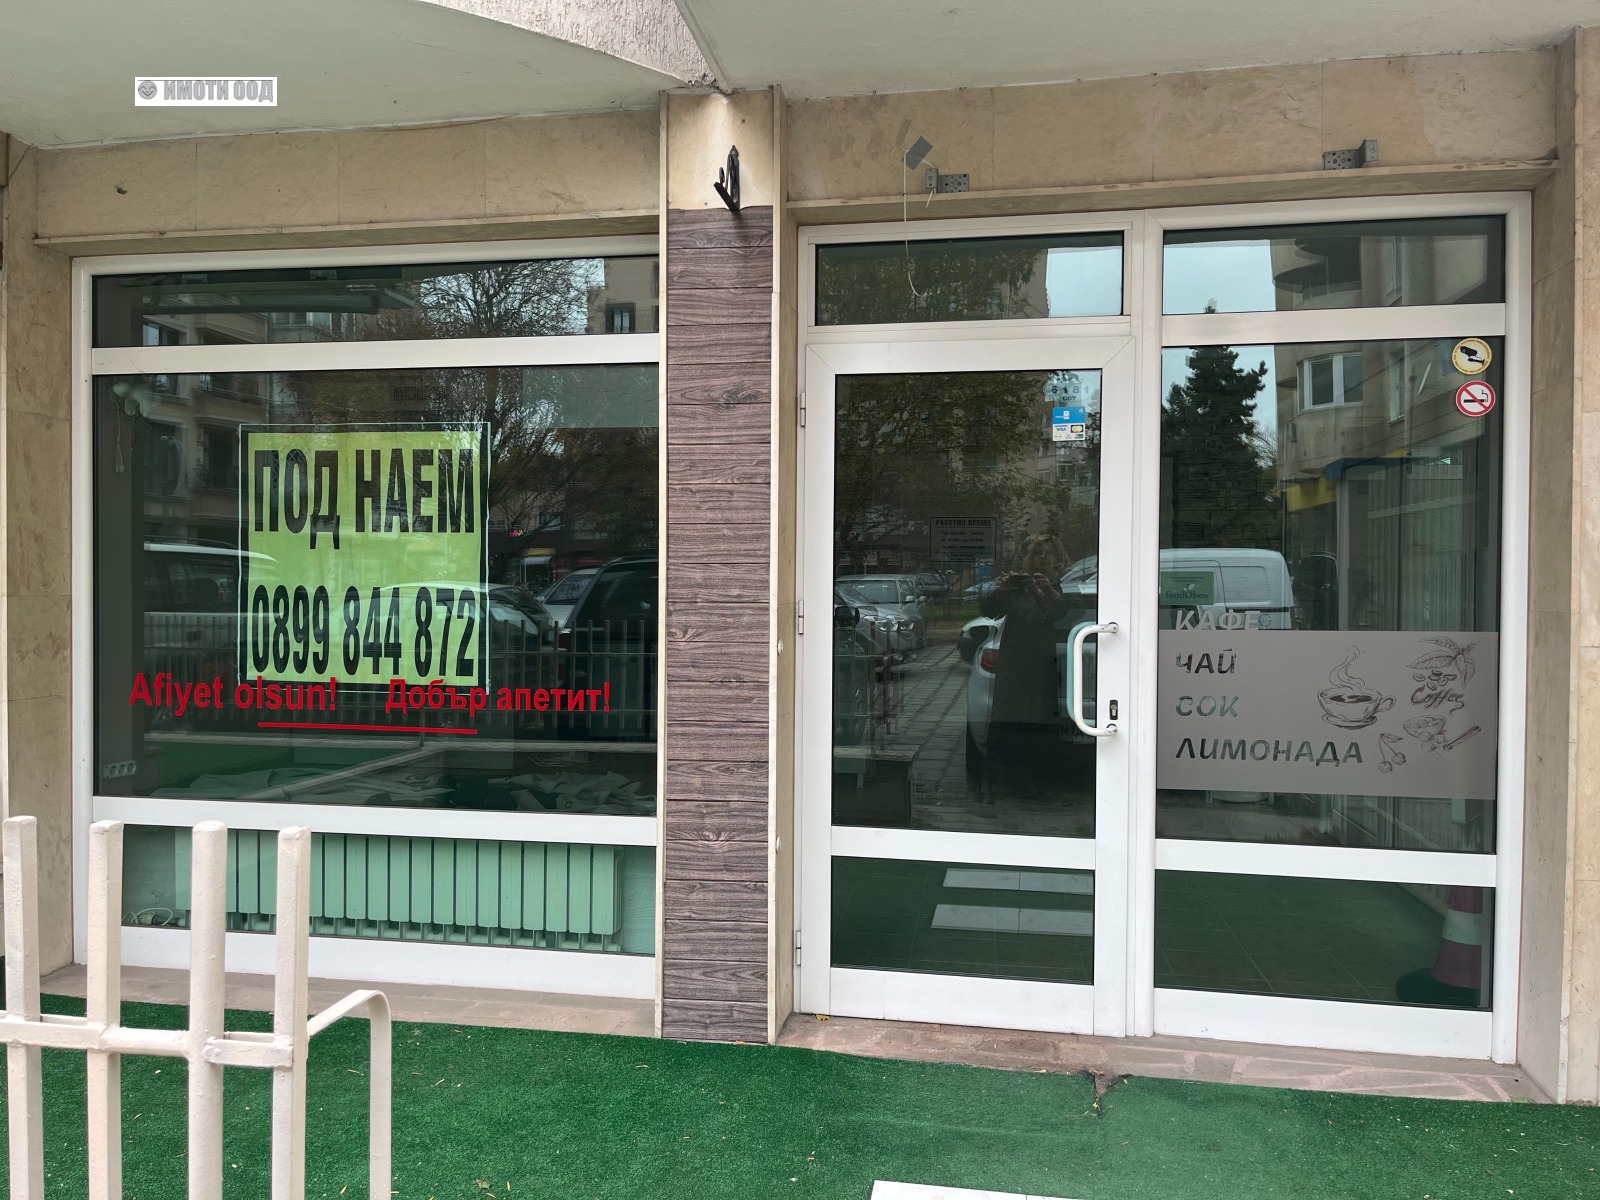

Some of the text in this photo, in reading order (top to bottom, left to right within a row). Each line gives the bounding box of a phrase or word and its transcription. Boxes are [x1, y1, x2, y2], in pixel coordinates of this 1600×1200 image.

[254, 448, 475, 550] ПОД НАЕМ
[252, 584, 476, 678] 0899 844 872
[1175, 609, 1260, 631] КАФЕ
[1175, 648, 1236, 674] ЧАЙ
[128, 672, 337, 717] Afiyet olsun!
[385, 678, 611, 718] Добър апетит!
[1175, 695, 1239, 717] СОК
[1175, 737, 1363, 767] ЛИМОНАДА
